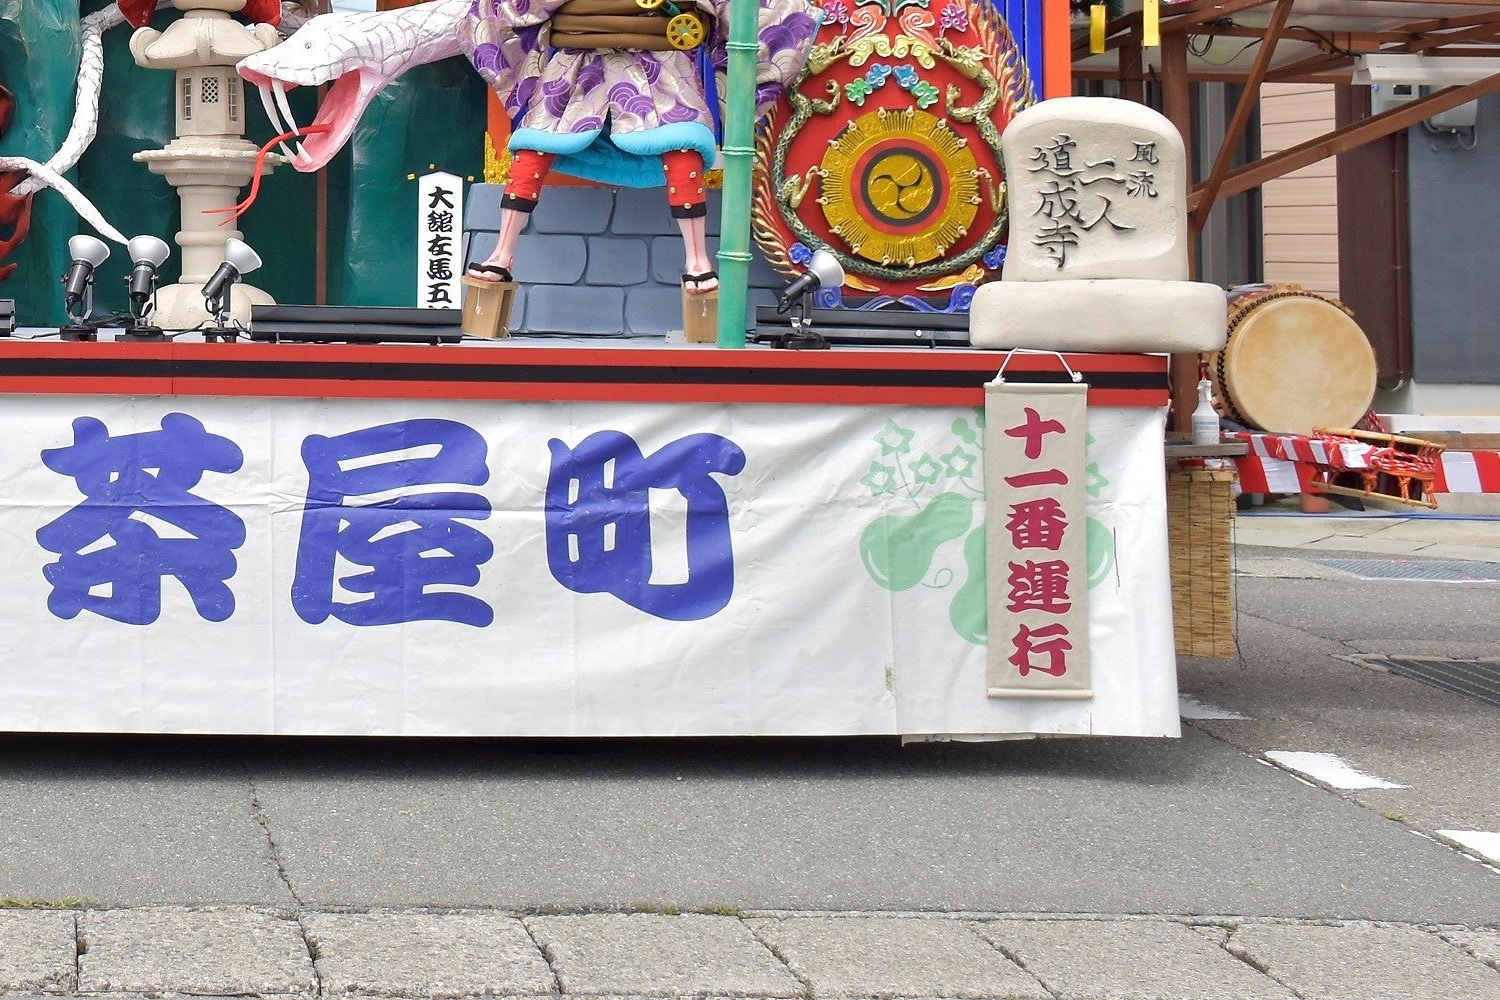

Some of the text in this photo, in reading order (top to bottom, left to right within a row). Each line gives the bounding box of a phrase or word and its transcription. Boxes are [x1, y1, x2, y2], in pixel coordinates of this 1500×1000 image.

[1027, 133, 1085, 269] 道成寺
[1078, 157, 1137, 232] 二人
[1127, 140, 1160, 198] 風流
[1004, 406, 1073, 677] 十一番運行
